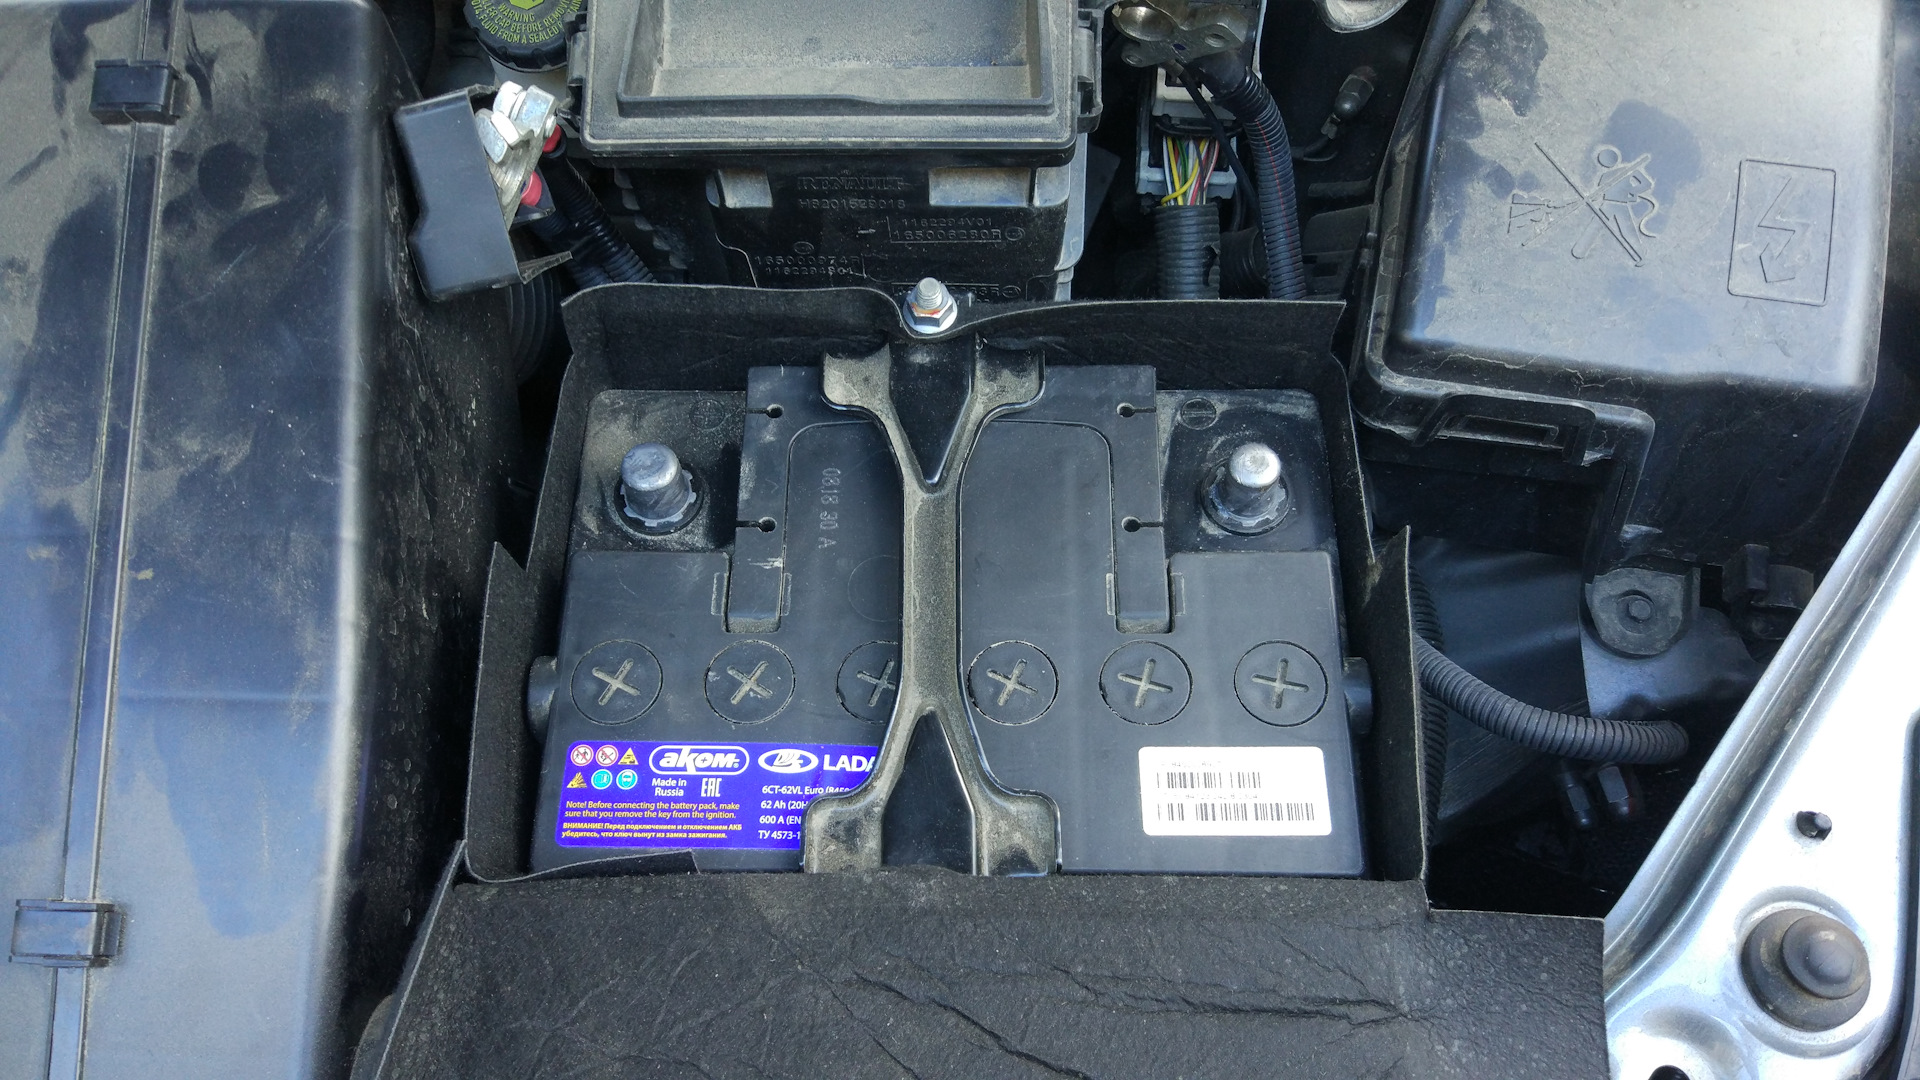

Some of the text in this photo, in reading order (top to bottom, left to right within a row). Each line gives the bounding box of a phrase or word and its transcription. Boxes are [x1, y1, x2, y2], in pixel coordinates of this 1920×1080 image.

[498, 2, 535, 22] WARNING
[479, 14, 498, 34] FLUID
[497, 29, 519, 43] FROM
[521, 35, 527, 44] A
[529, 25, 559, 43] SEALED
[495, 15, 511, 29] CAP
[510, 20, 543, 33] BEFORE
[817, 536, 837, 549] A
[652, 777, 687, 787] Made in
[654, 787, 684, 797] Russia
[804, 786, 824, 795] Euro
[565, 800, 587, 809] Note!
[588, 800, 612, 809] Before
[613, 801, 655, 811] connecting
[670, 802, 698, 811] battery
[698, 802, 718, 811] pack,
[719, 802, 740, 810] make
[760, 800, 772, 809] 62
[773, 800, 786, 809] Ah
[598, 811, 613, 819] you
[644, 810, 657, 818] the
[658, 810, 671, 819] key
[705, 811, 736, 820] ignition.
[759, 815, 775, 824] 600
[777, 815, 785, 824] A
[604, 823, 626, 831] Перед
[728, 823, 743, 831] АКБ
[561, 830, 600, 838] убедитесь,
[758, 830, 801, 840] ТУ 4573-1
